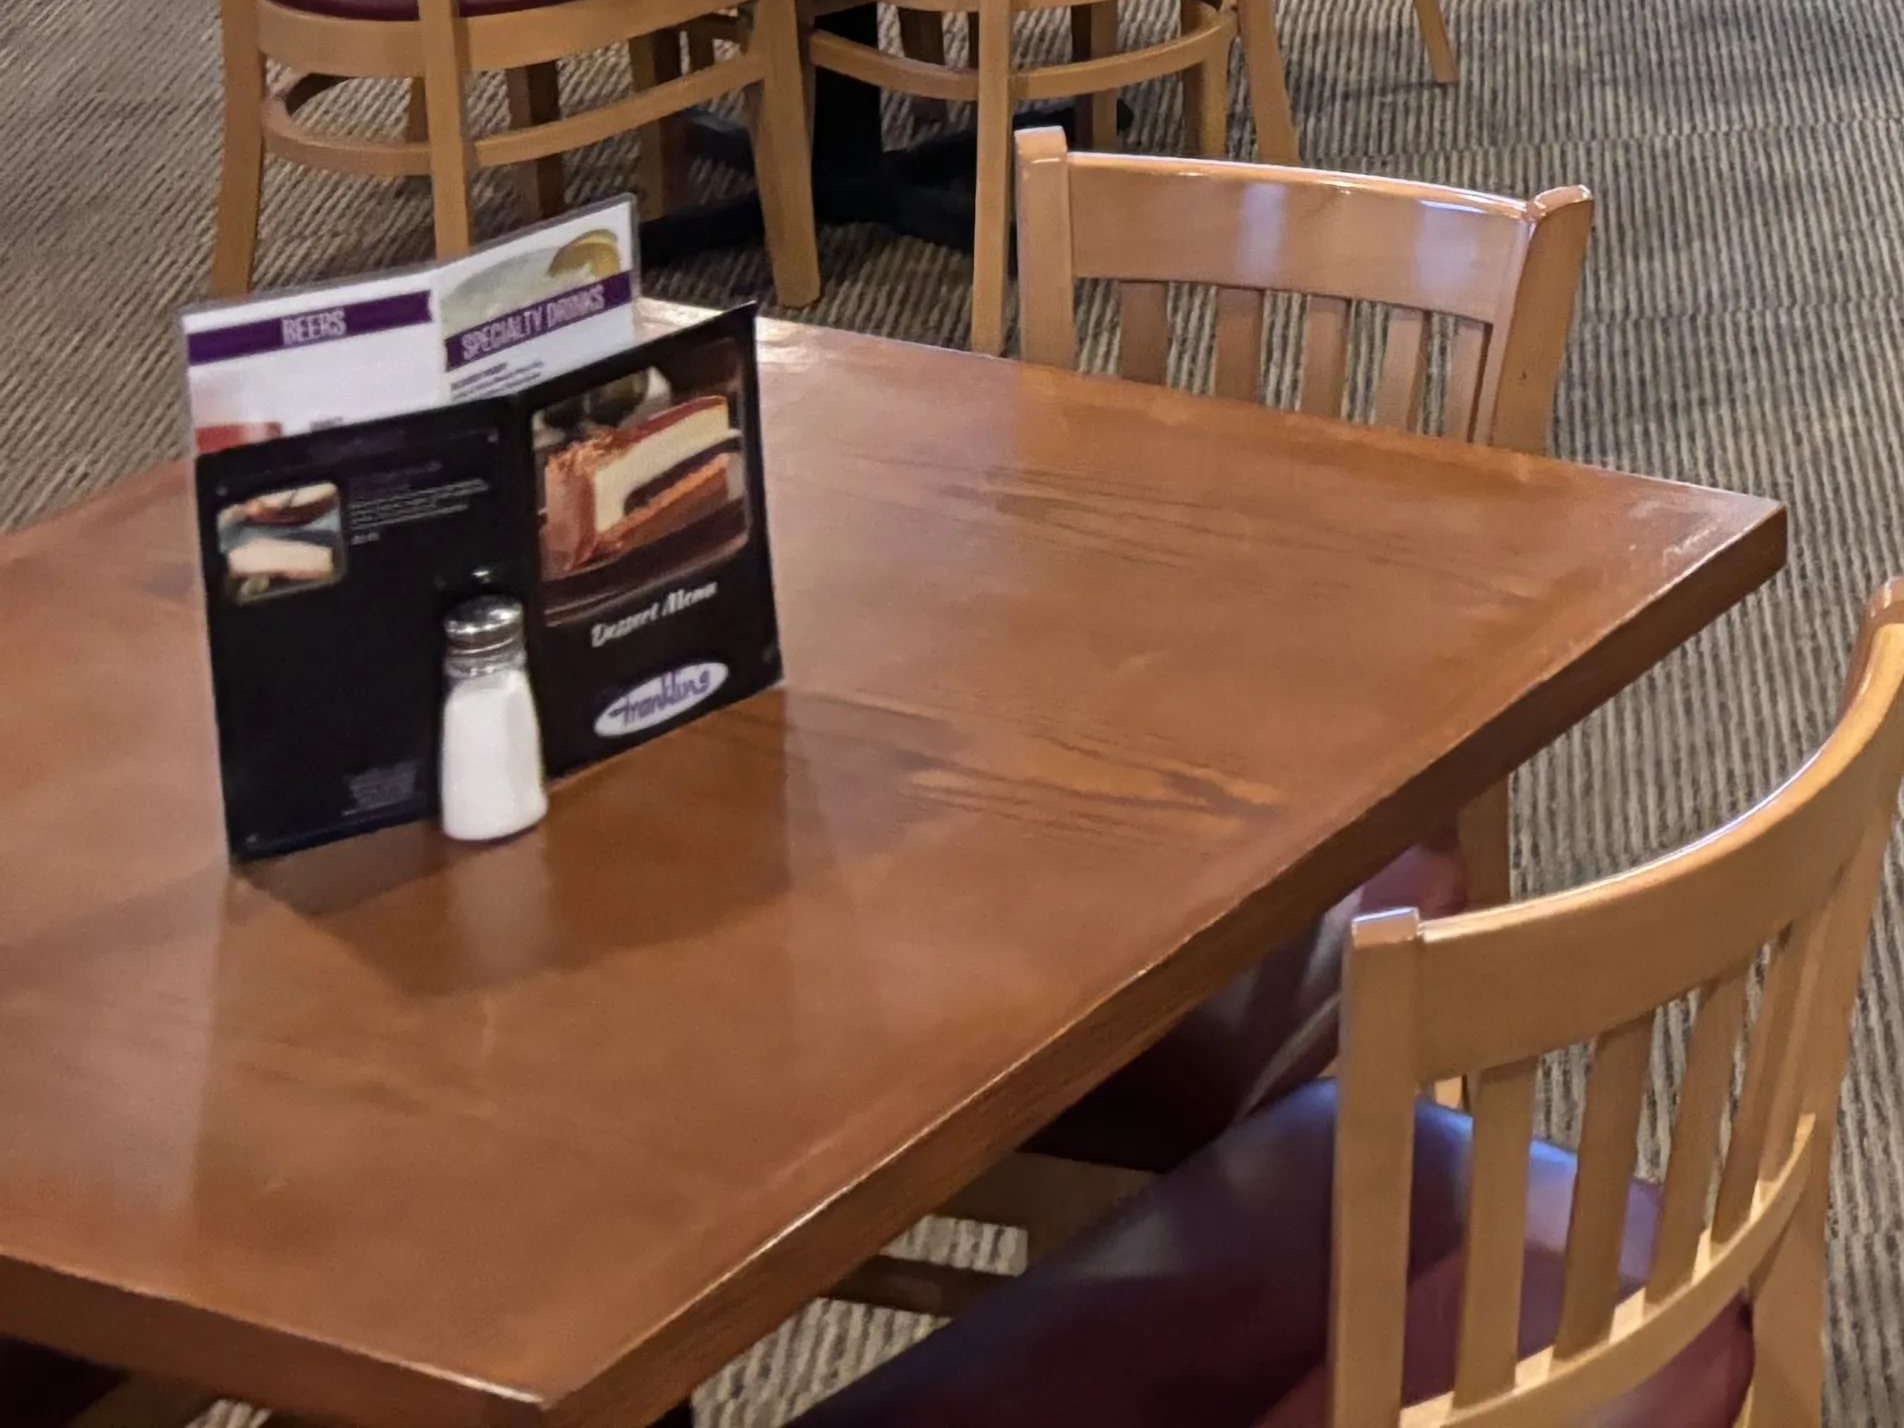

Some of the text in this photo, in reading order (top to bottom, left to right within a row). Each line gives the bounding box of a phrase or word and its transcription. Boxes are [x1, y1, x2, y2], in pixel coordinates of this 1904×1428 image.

[282, 308, 347, 346] BEERS
[461, 306, 543, 361] SPECIALTY
[591, 602, 660, 649] Dessert
